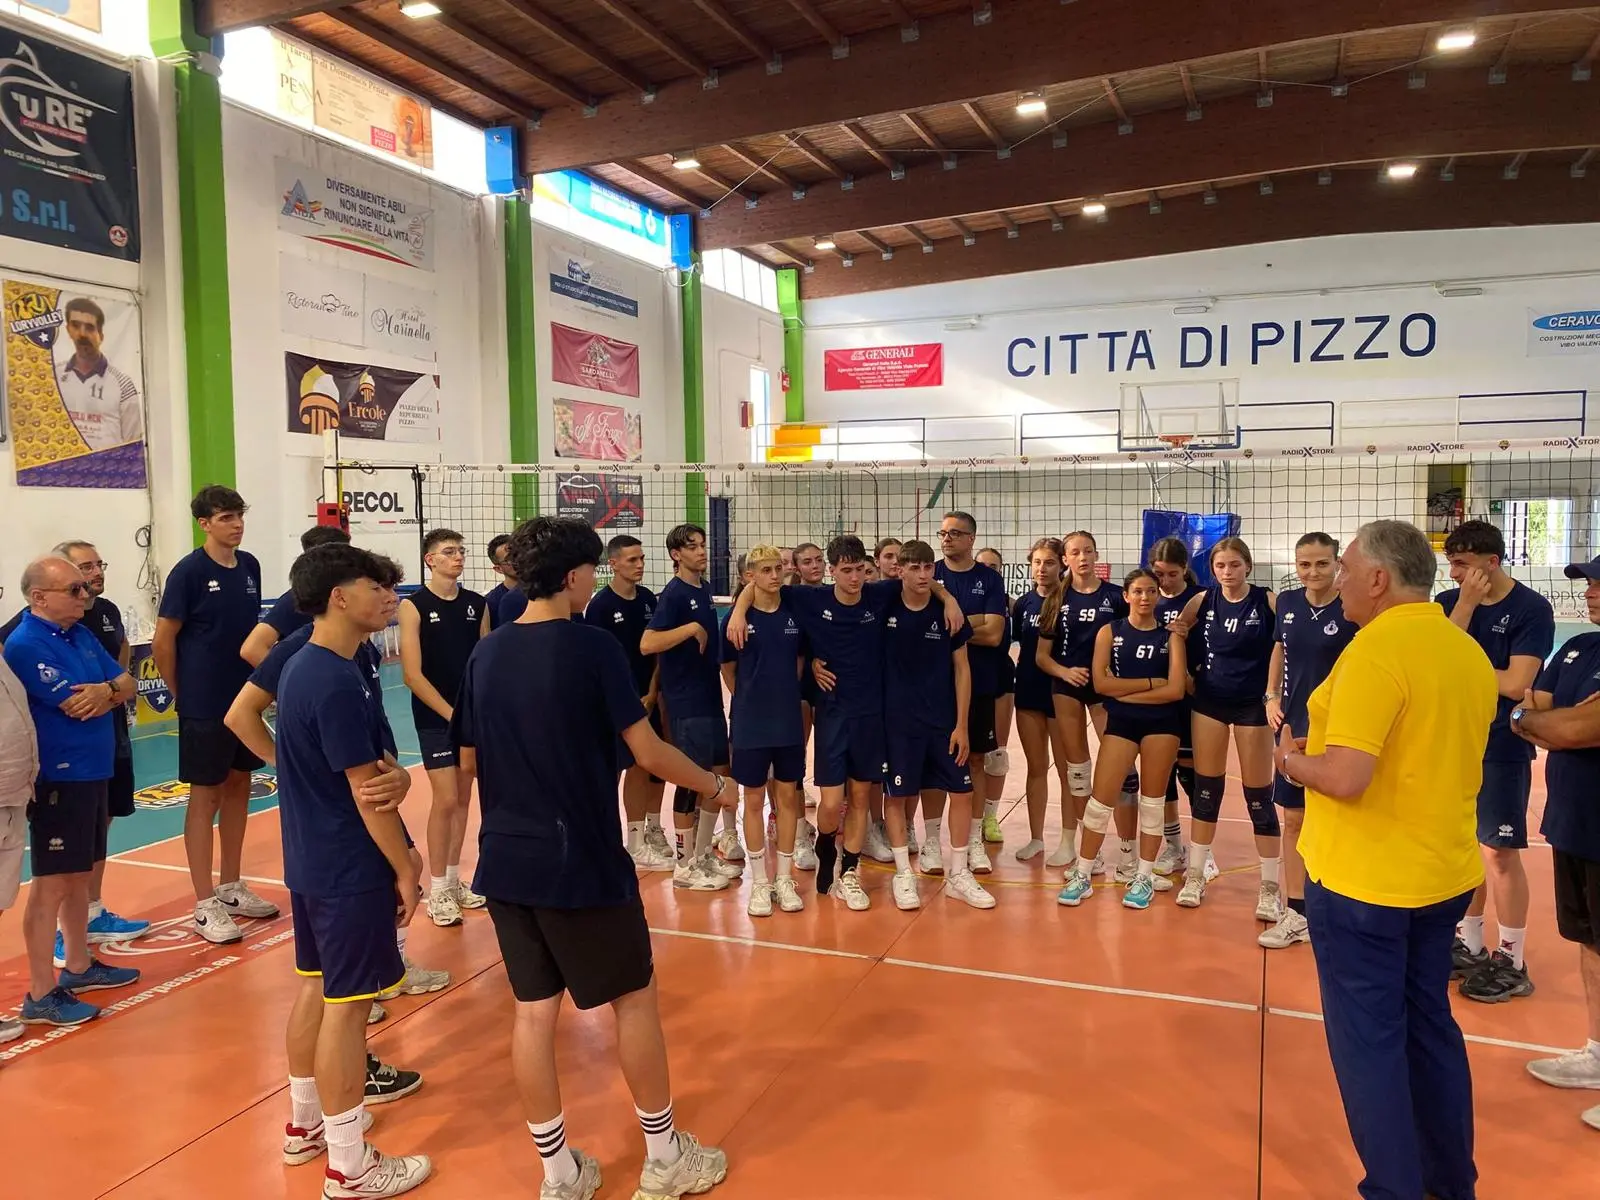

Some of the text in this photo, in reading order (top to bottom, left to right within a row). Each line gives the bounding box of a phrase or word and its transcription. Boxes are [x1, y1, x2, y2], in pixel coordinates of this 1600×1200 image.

[326, 178, 406, 214] DIVERSAMENTE ABILI
[12, 189, 76, 233] S.r.l.
[340, 198, 396, 225] NON SIGNIFICA
[324, 208, 372, 232] RINUNCIARE
[374, 222, 393, 238] ALLA
[394, 228, 410, 244] VITA
[11, 310, 63, 332] LORYVOLLEY
[370, 307, 431, 342] Marinella
[1180, 324, 1228, 369] DI
[1250, 312, 1436, 365] PIZZO
[865, 347, 914, 360] GENERALI
[89, 382, 104, 400] 11
[348, 402, 386, 420] Ercole
[1078, 608, 1096, 622] 59
[1164, 610, 1179, 624] 39
[1224, 618, 1238, 632] 41
[1136, 645, 1154, 659] 67
[894, 775, 902, 786] 6
[676, 834, 684, 860] FILA
